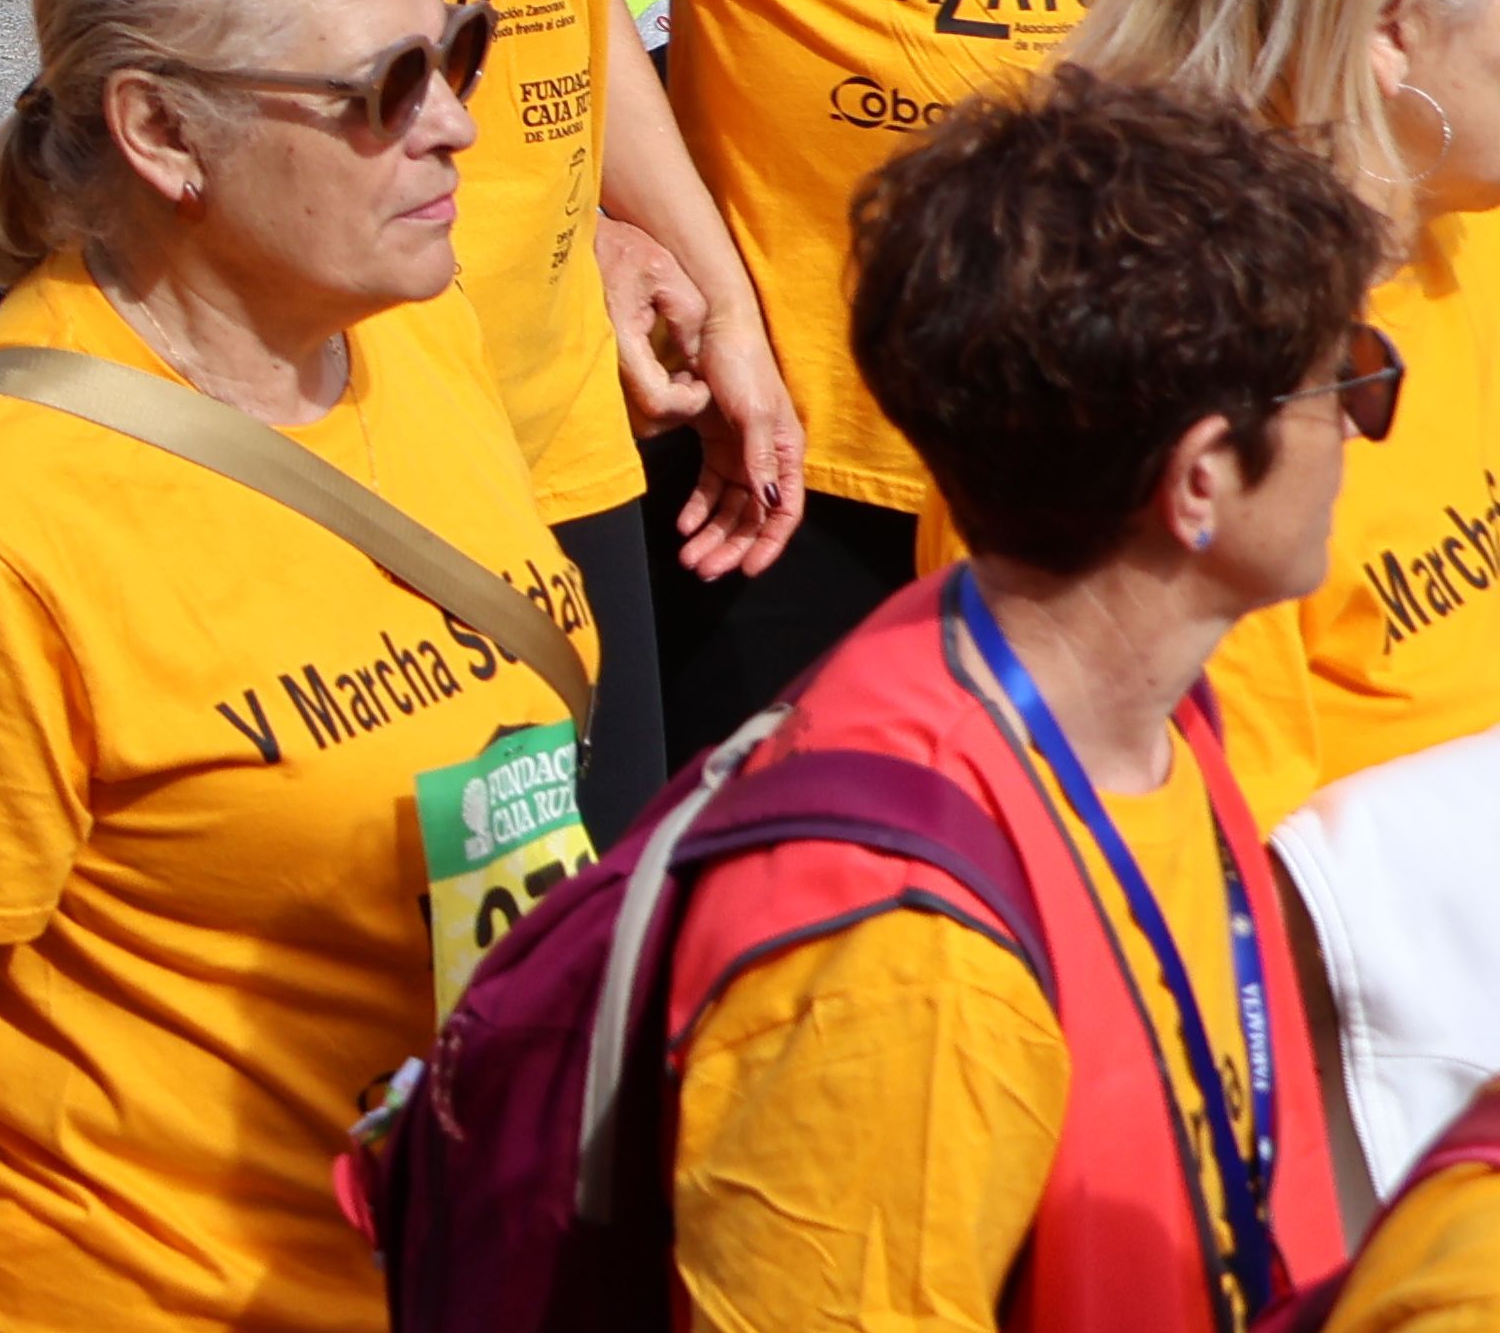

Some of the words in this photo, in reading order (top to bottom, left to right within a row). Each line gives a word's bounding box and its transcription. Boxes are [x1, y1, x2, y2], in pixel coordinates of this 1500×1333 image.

[215, 689, 283, 767] V
[278, 623, 457, 753] Marcha
[1241, 979, 1272, 1093] FARMACIA
